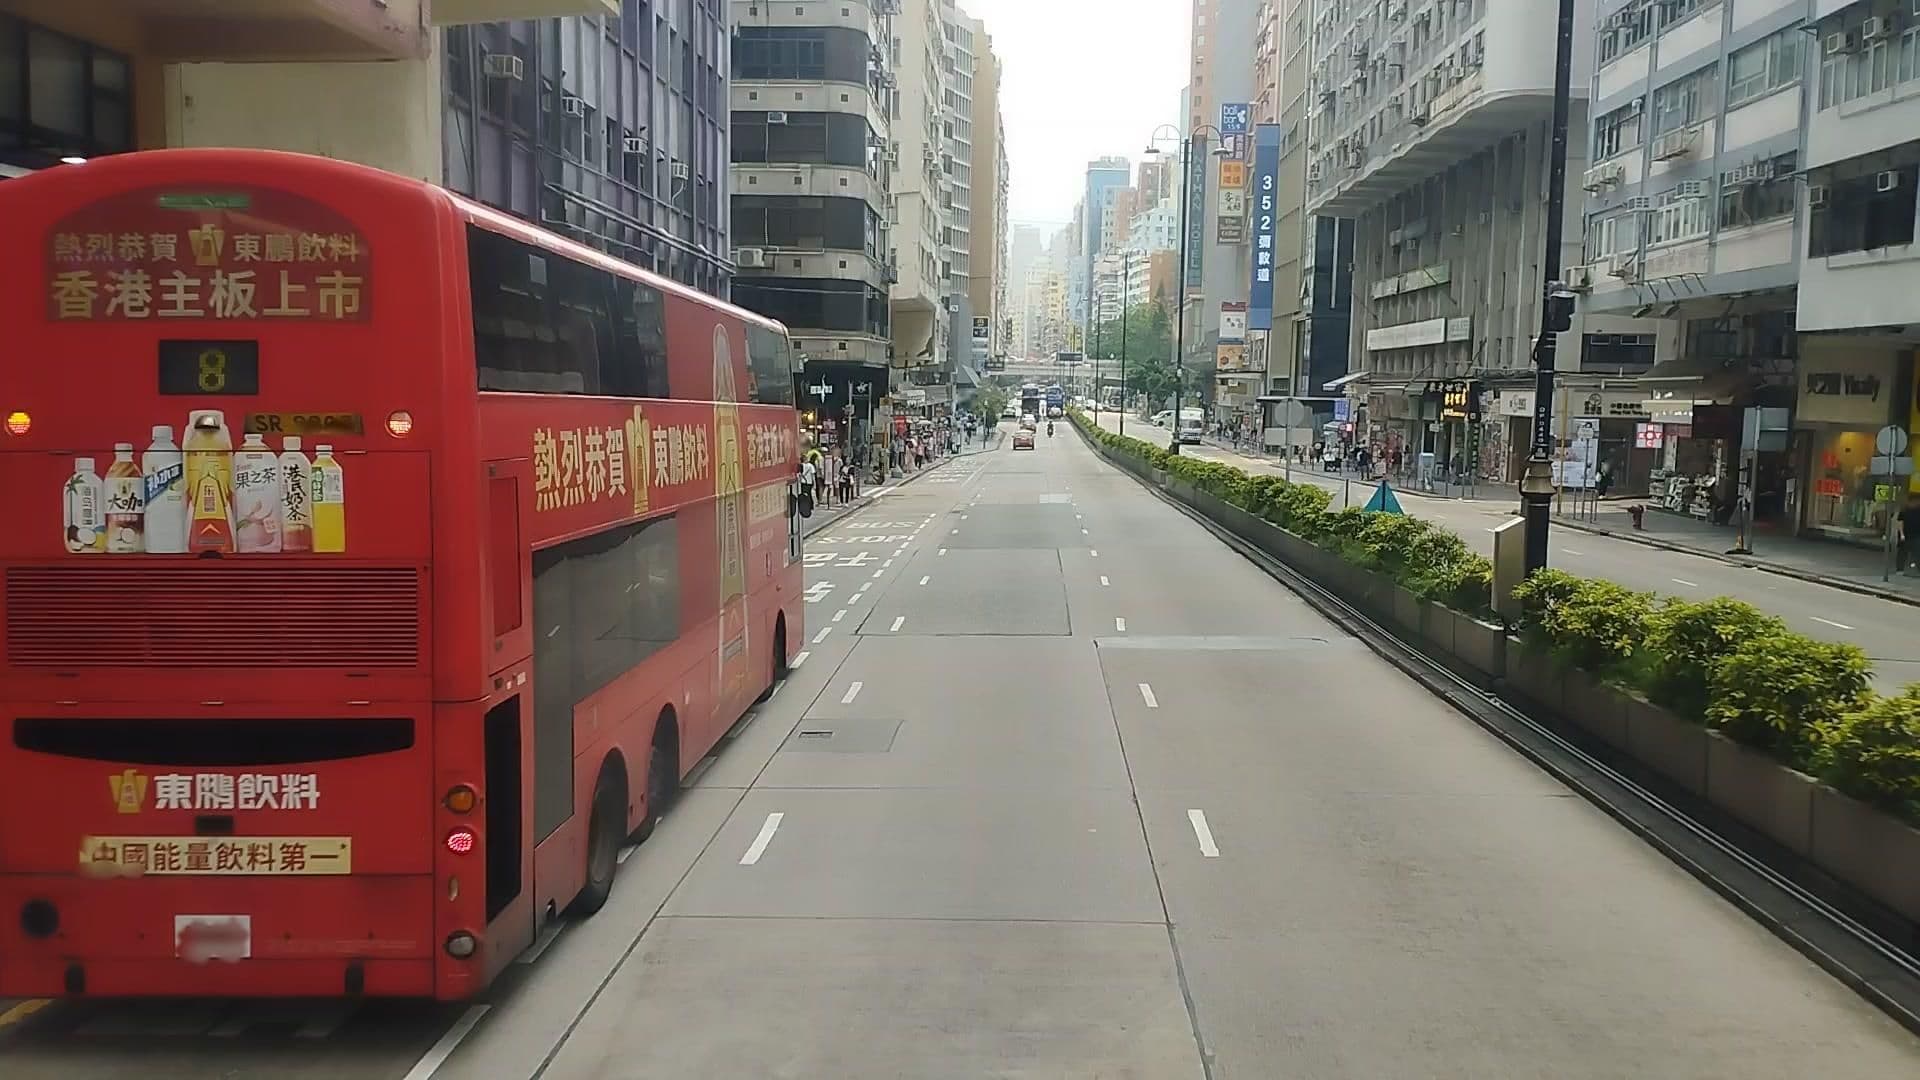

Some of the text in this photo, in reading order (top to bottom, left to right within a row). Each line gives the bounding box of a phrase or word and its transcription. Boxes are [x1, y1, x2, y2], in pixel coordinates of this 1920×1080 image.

[54, 233, 360, 263] 熱烈恭賀 東鵬飲料
[52, 270, 363, 319] 香港主板上市
[198, 350, 226, 392] 8
[236, 466, 276, 488] 果之茶
[533, 424, 709, 512] 熱烈恭賀 東鵬飲料
[108, 491, 143, 511] 大咖
[153, 774, 320, 810] 東鵬飲料
